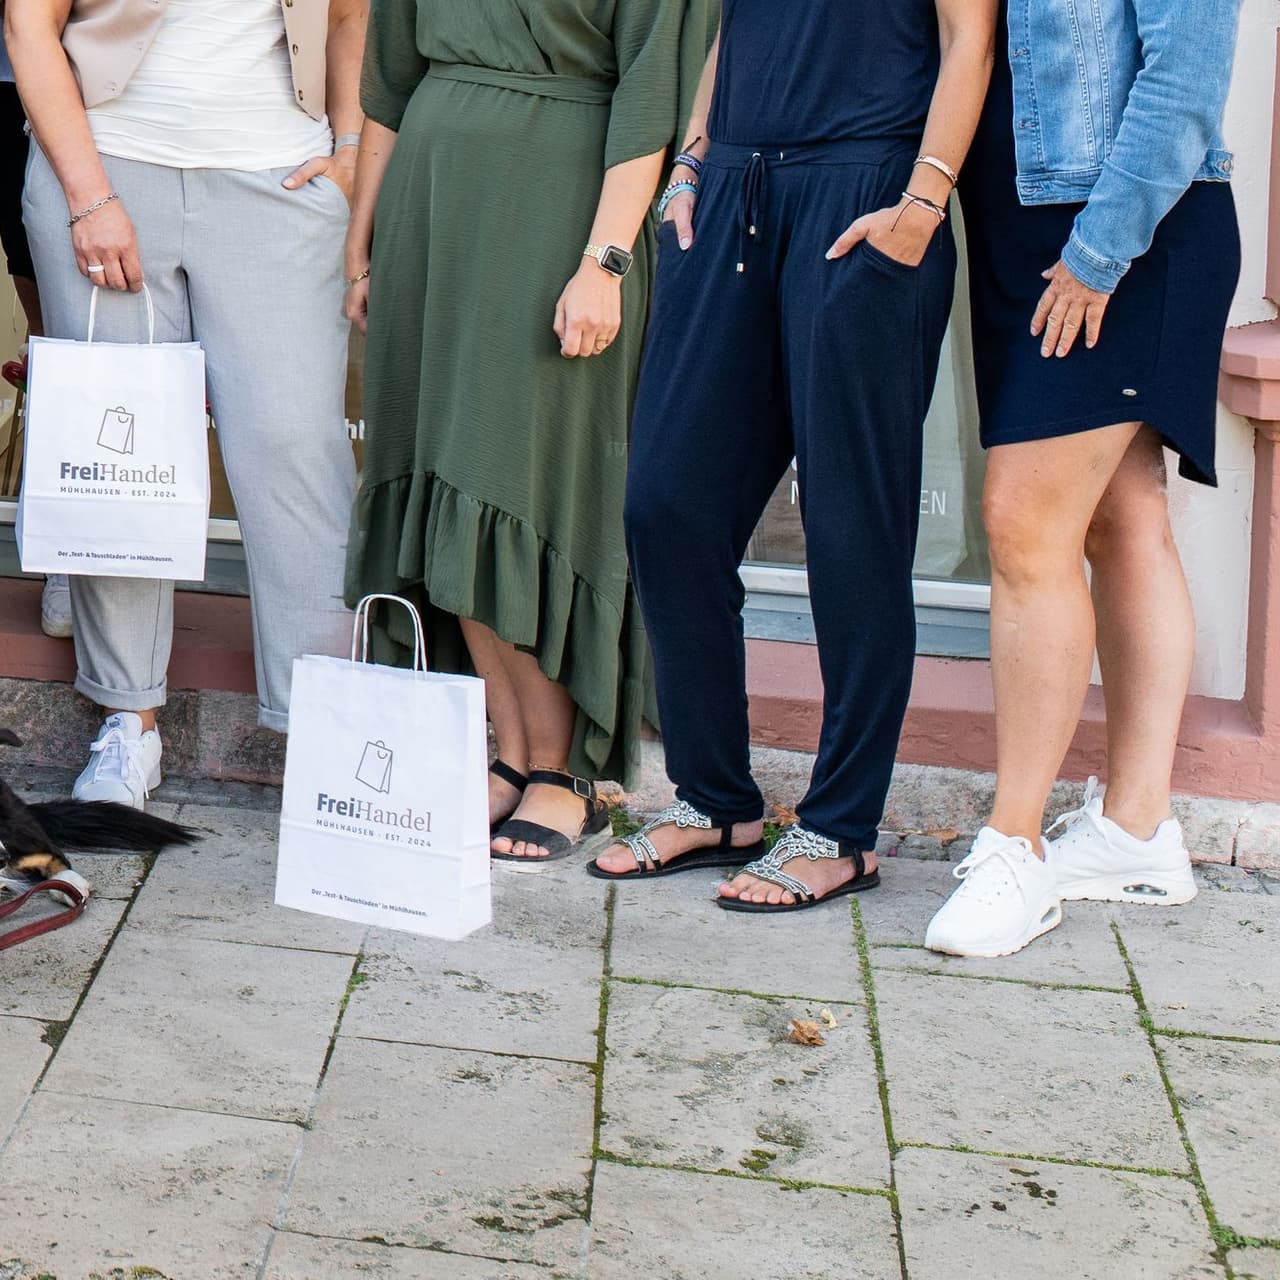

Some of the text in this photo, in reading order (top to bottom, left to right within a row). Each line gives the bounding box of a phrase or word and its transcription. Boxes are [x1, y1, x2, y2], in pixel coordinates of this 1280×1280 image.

[60, 486, 121, 495] MÜHLHAUSEN
[316, 819, 374, 837] MÜHLHAUSEN
[385, 833, 404, 843] EST.
[407, 837, 432, 847] 2024
